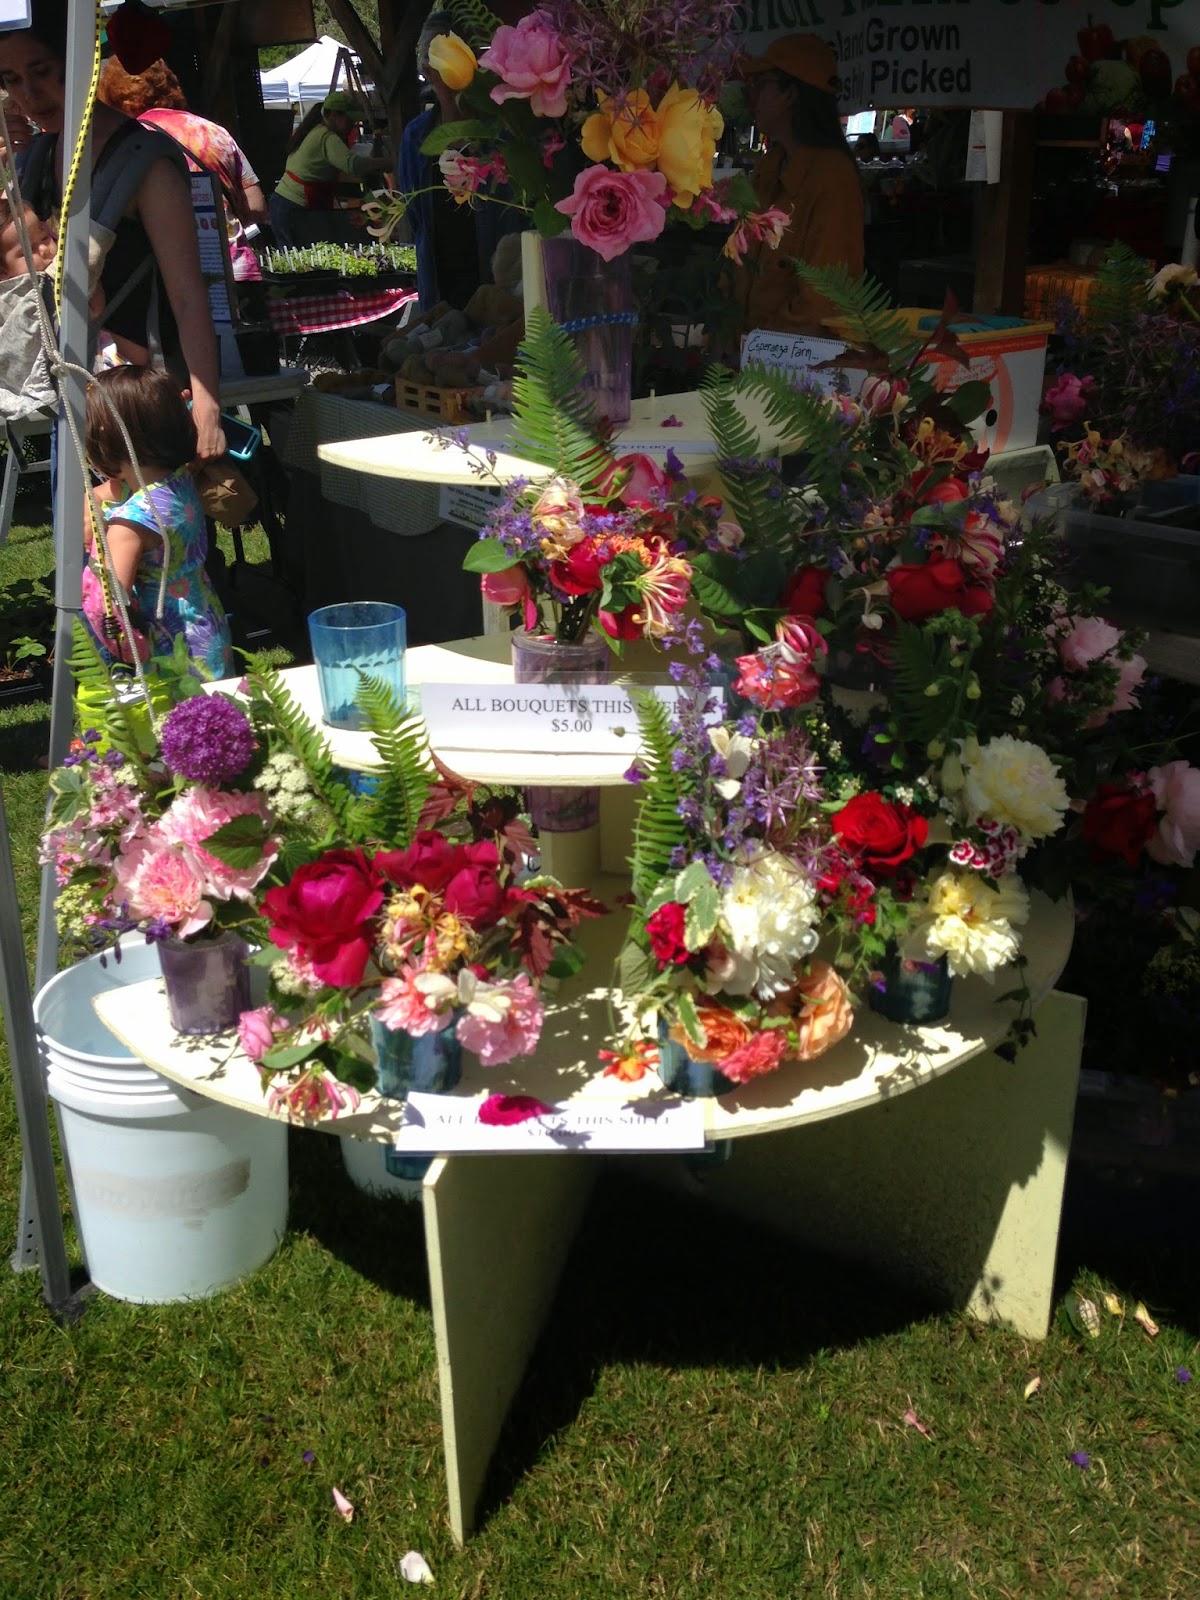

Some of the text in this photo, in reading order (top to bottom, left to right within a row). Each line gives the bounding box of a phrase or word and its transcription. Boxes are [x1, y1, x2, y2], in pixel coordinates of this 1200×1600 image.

[866, 18, 960, 52] Grown
[870, 59, 971, 95] Picked
[747, 335, 789, 359] Esperanza
[452, 697, 487, 711] ALL
[491, 698, 588, 715] BOUQUETS
[592, 699, 632, 714] THIS
[551, 718, 592, 733] $5.00
